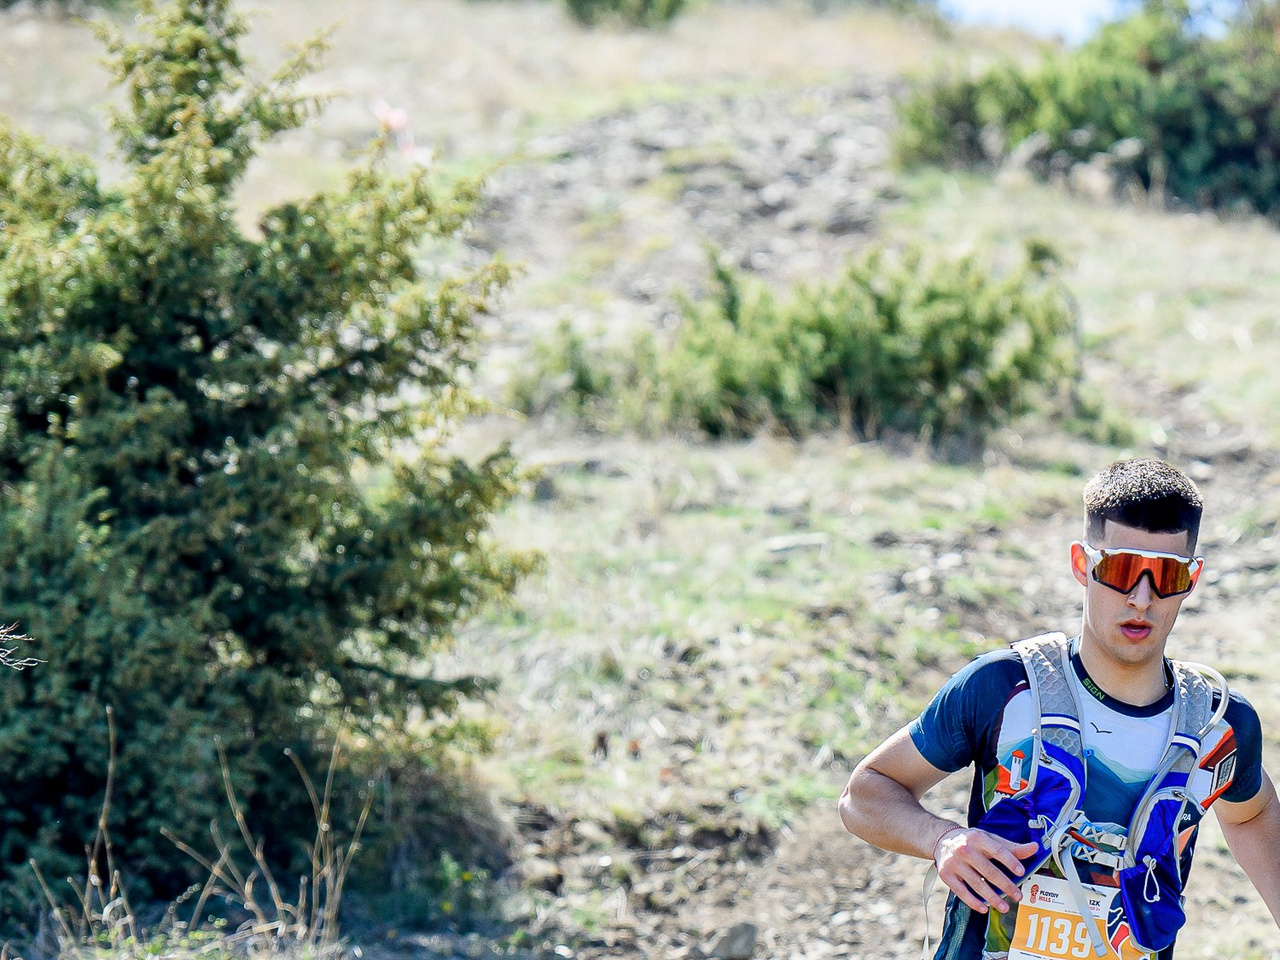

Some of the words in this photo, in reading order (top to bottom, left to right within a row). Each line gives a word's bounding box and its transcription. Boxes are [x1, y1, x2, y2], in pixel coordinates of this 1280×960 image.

[1039, 890, 1059, 898] PLOVDIV
[1089, 899, 1101, 907] 12K
[1025, 913, 1092, 959] 1139
